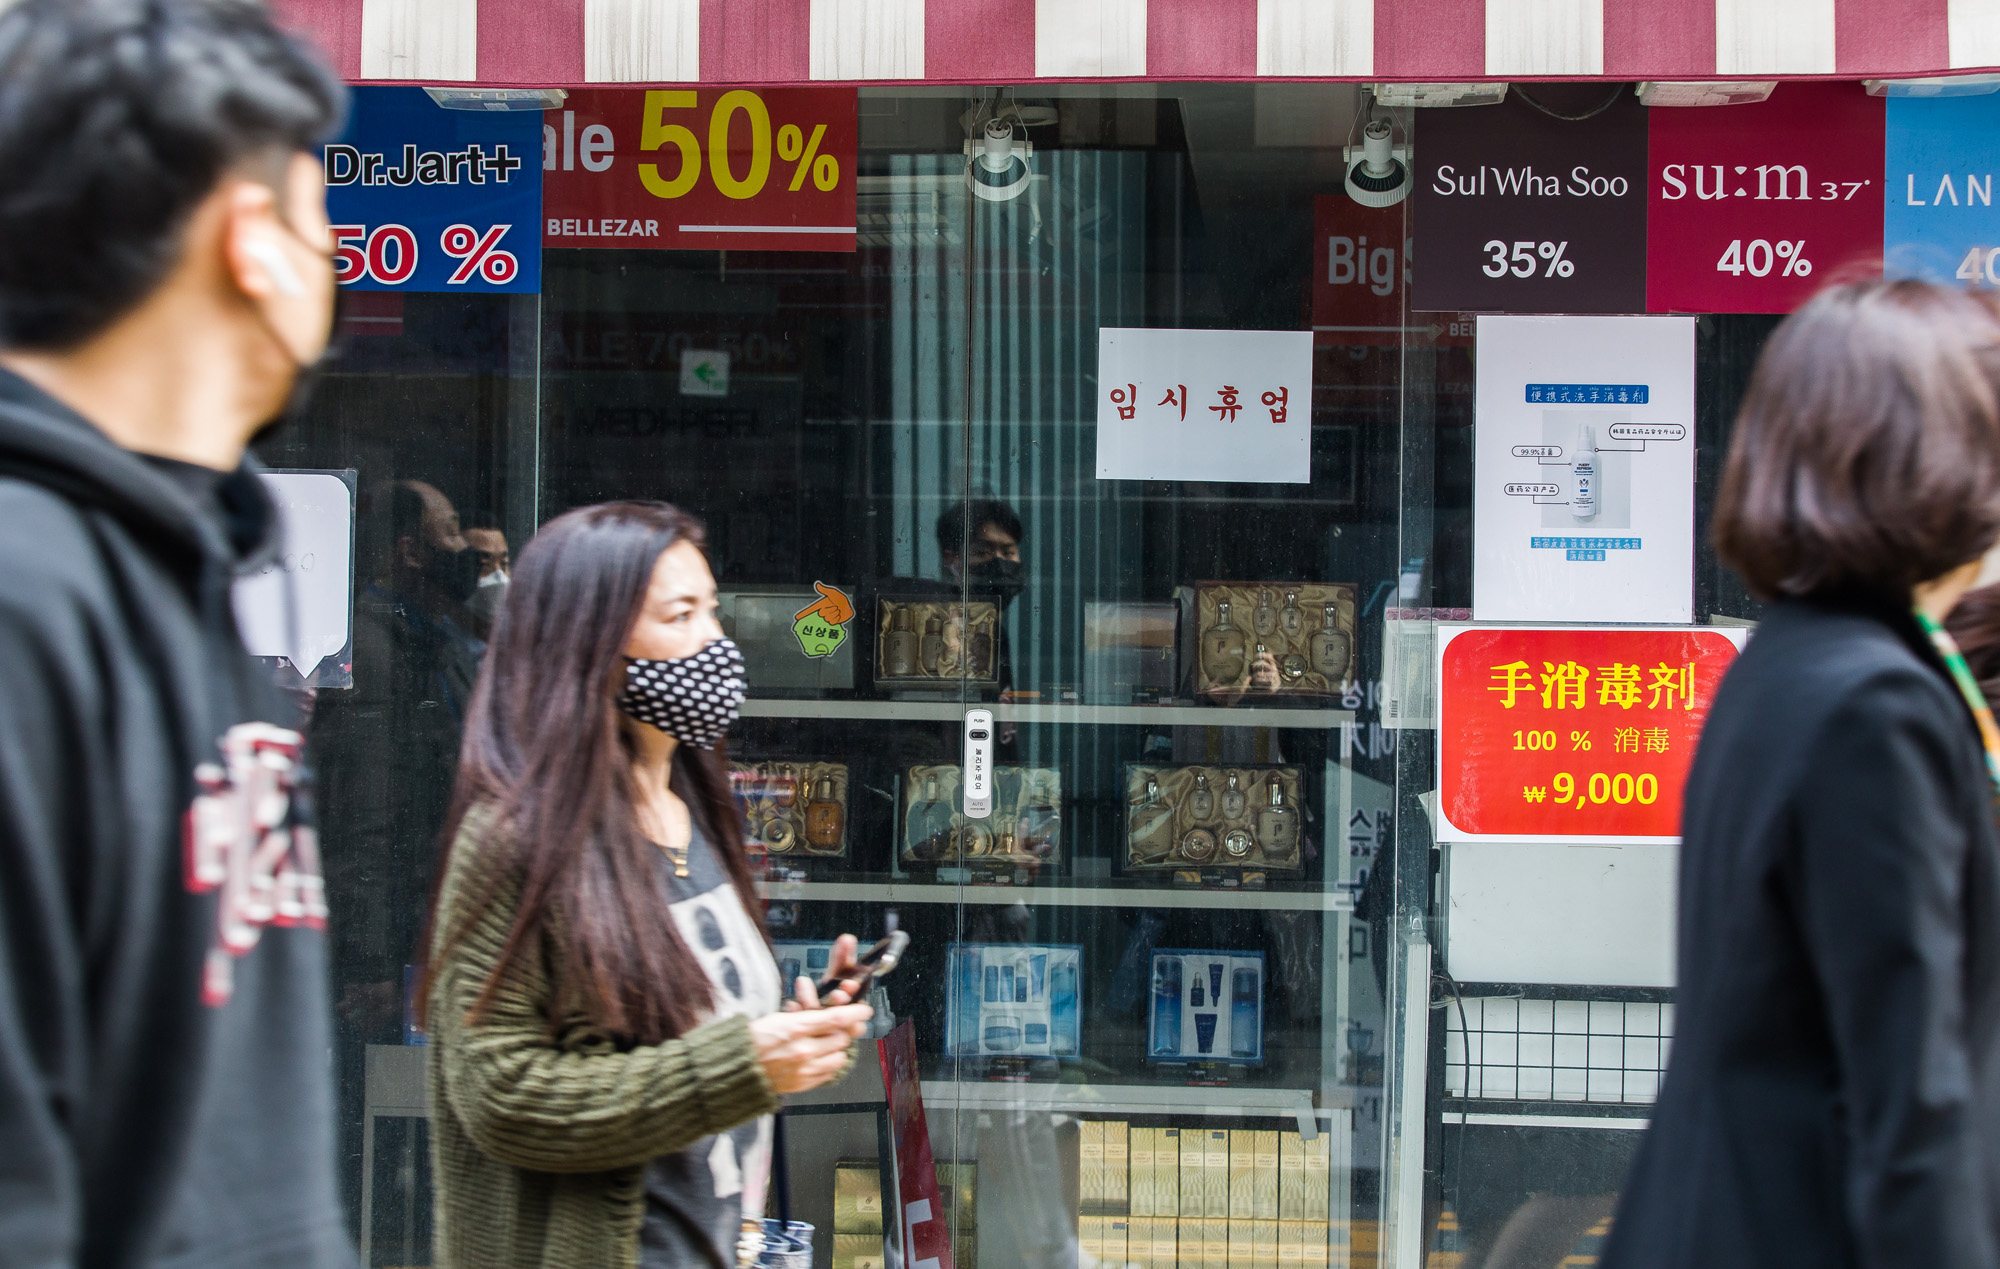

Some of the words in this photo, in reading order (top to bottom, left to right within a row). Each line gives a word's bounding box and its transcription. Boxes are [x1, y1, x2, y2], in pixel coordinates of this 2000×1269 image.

[638, 90, 839, 199] 50%
[325, 144, 521, 186] Dr.Jart+
[547, 219, 659, 236] BELLEZAR
[1482, 239, 1575, 278] 35%
[1717, 239, 1812, 277] 40%
[802, 625, 839, 640] 신상품
[1487, 660, 1695, 710] 手消毒剂
[1513, 730, 1557, 751] 100
[1570, 730, 1592, 751] %
[1613, 726, 1670, 754] 消毒
